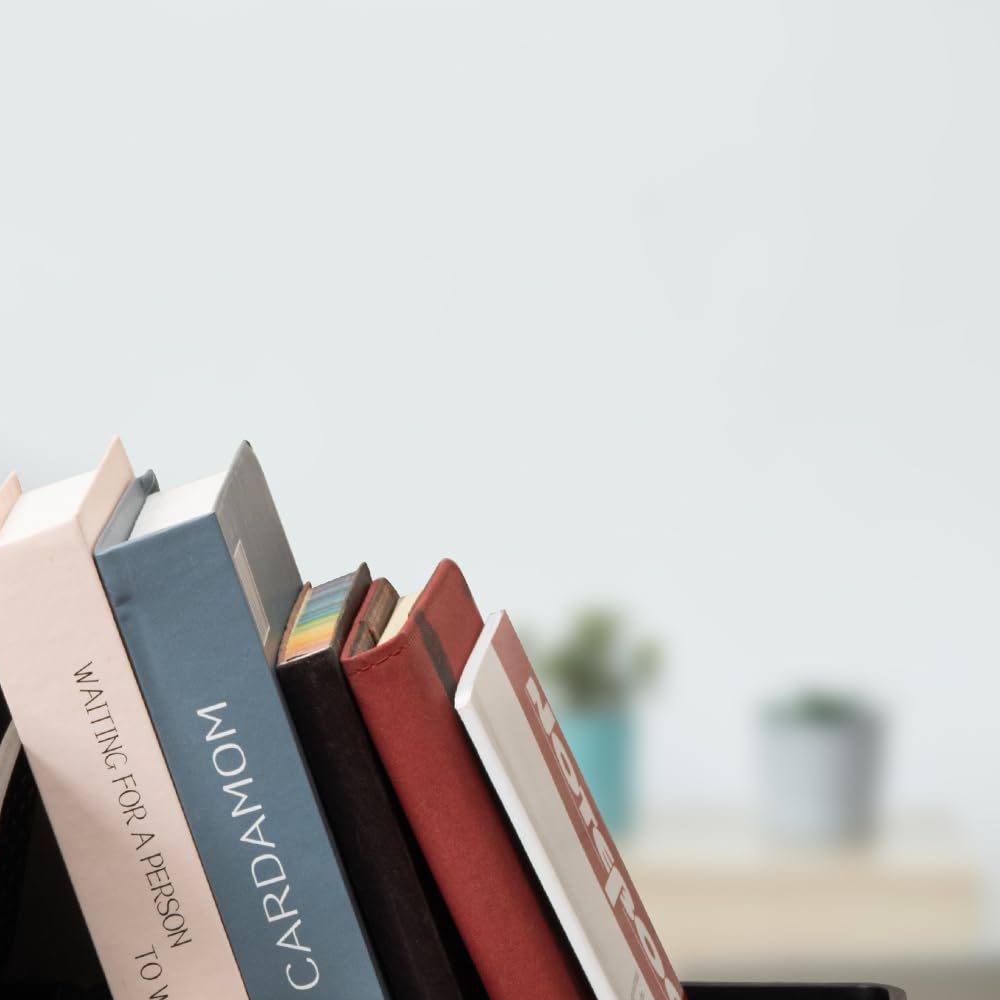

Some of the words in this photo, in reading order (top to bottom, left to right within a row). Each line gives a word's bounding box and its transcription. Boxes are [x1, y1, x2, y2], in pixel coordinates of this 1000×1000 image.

[72, 660, 127, 772] WAITING
[111, 773, 148, 826] FOR
[130, 829, 155, 852] A
[196, 701, 320, 992] CARDAMOM
[139, 852, 192, 949] PERSON
[134, 943, 163, 981] TO
